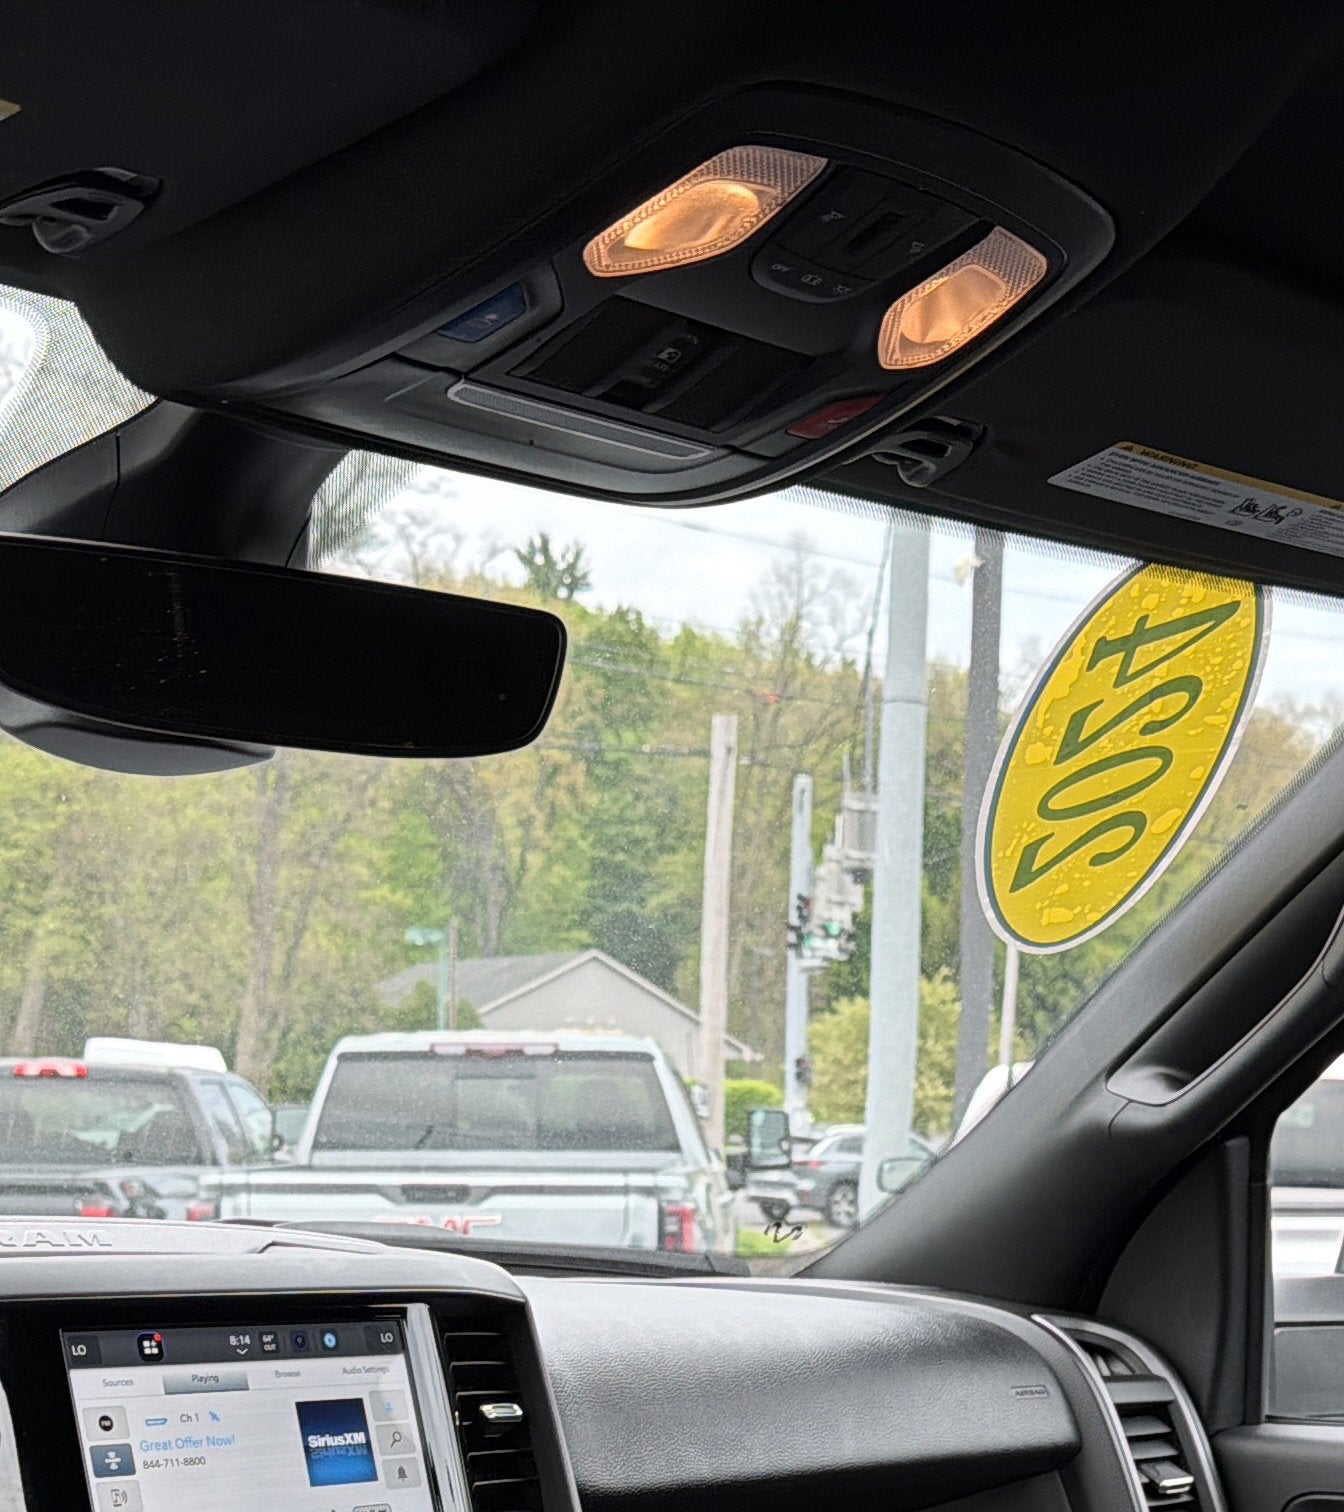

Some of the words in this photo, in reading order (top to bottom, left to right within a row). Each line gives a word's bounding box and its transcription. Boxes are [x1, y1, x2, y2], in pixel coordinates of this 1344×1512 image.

[229, 1335, 251, 1346] 8:14
[380, 1332, 394, 1343] LO
[102, 1378, 134, 1387] Sources
[191, 1374, 219, 1384] Playing
[179, 1413, 192, 1423] Ch
[140, 1440, 172, 1452] Great
[175, 1437, 203, 1449] Offer
[206, 1435, 236, 1447] Now!
[308, 1432, 366, 1448] SiriusXM
[142, 1455, 206, 1469] 844-711-8800
